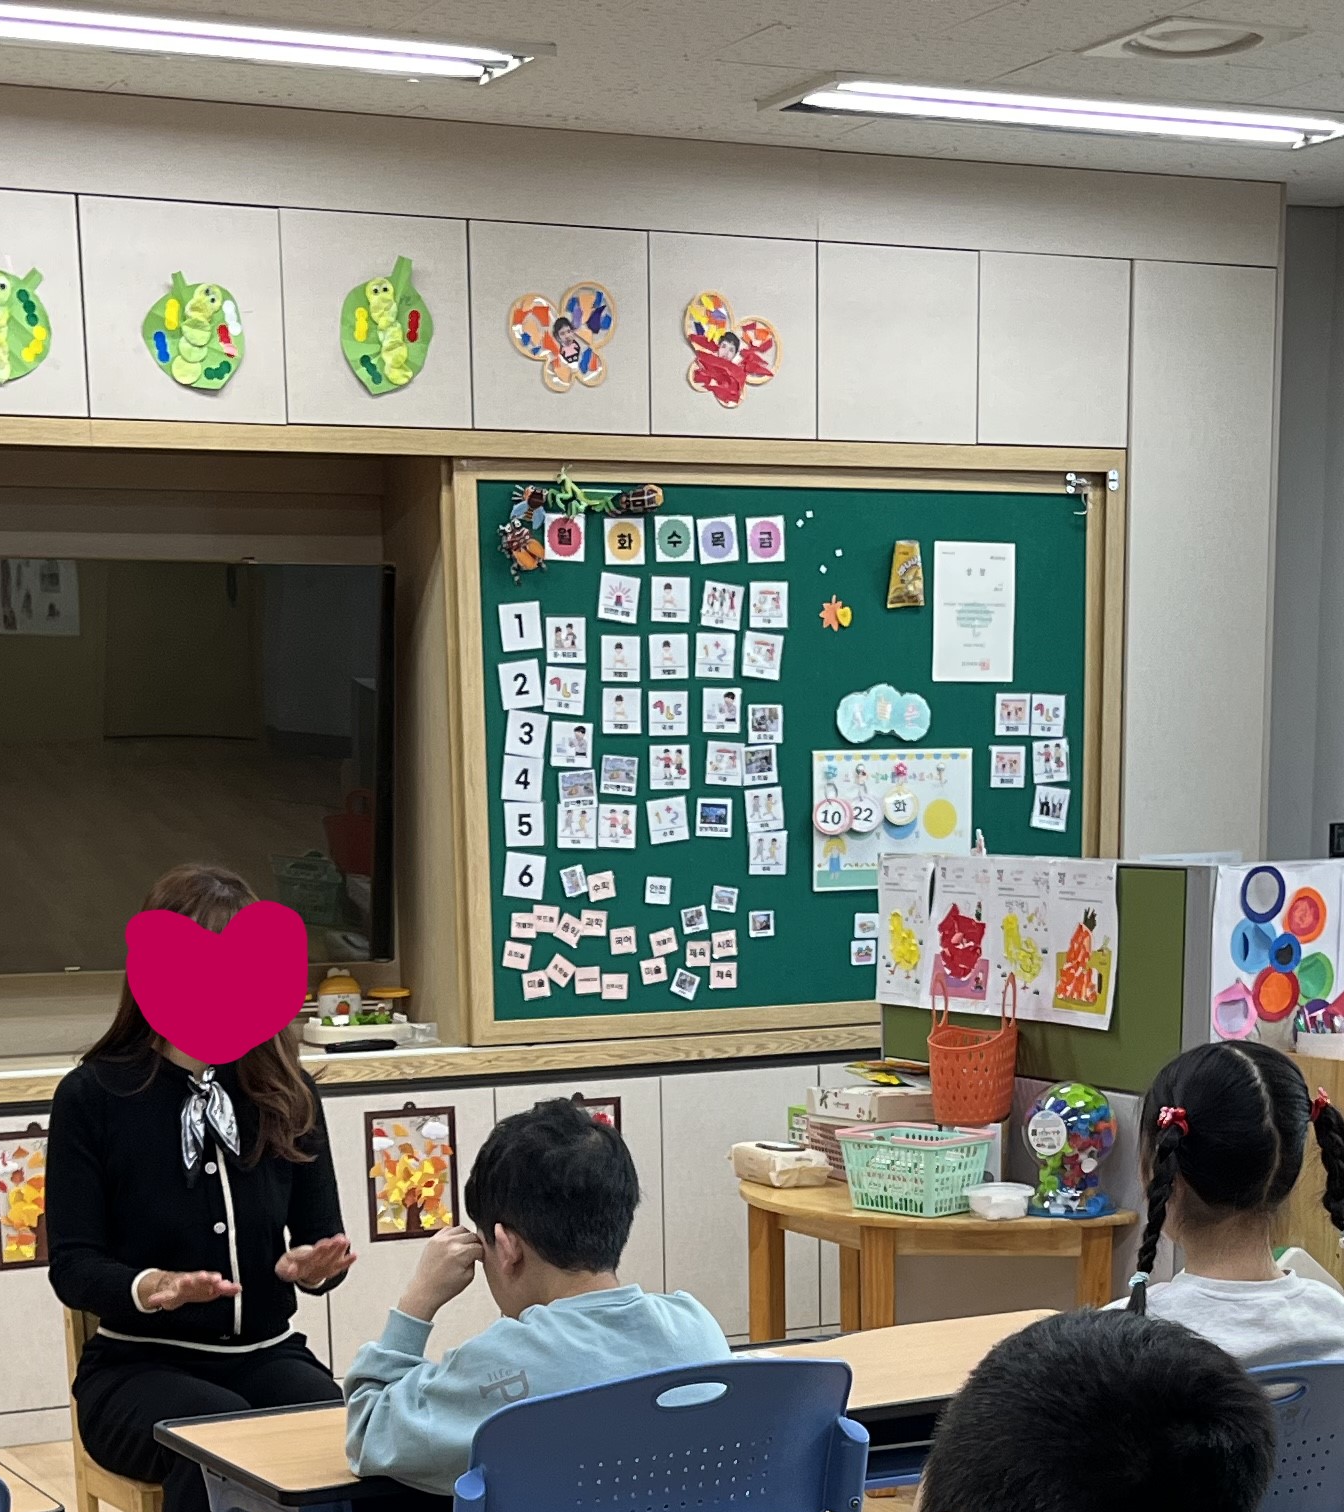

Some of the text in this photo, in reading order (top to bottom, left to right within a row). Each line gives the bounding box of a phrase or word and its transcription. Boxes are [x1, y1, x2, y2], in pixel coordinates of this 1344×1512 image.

[558, 528, 572, 546] 월
[617, 533, 633, 550] 화
[667, 530, 683, 548] 수
[711, 531, 726, 548] 목
[759, 531, 773, 548] 금
[514, 613, 524, 638] 1
[513, 673, 529, 696] 2
[519, 722, 534, 745] 3
[515, 768, 530, 790] 4
[853, 807, 873, 822] 22
[894, 800, 907, 813] 화
[518, 813, 532, 836] 5
[821, 810, 842, 825] 10
[519, 864, 533, 887] 6
[615, 935, 632, 946] 국어
